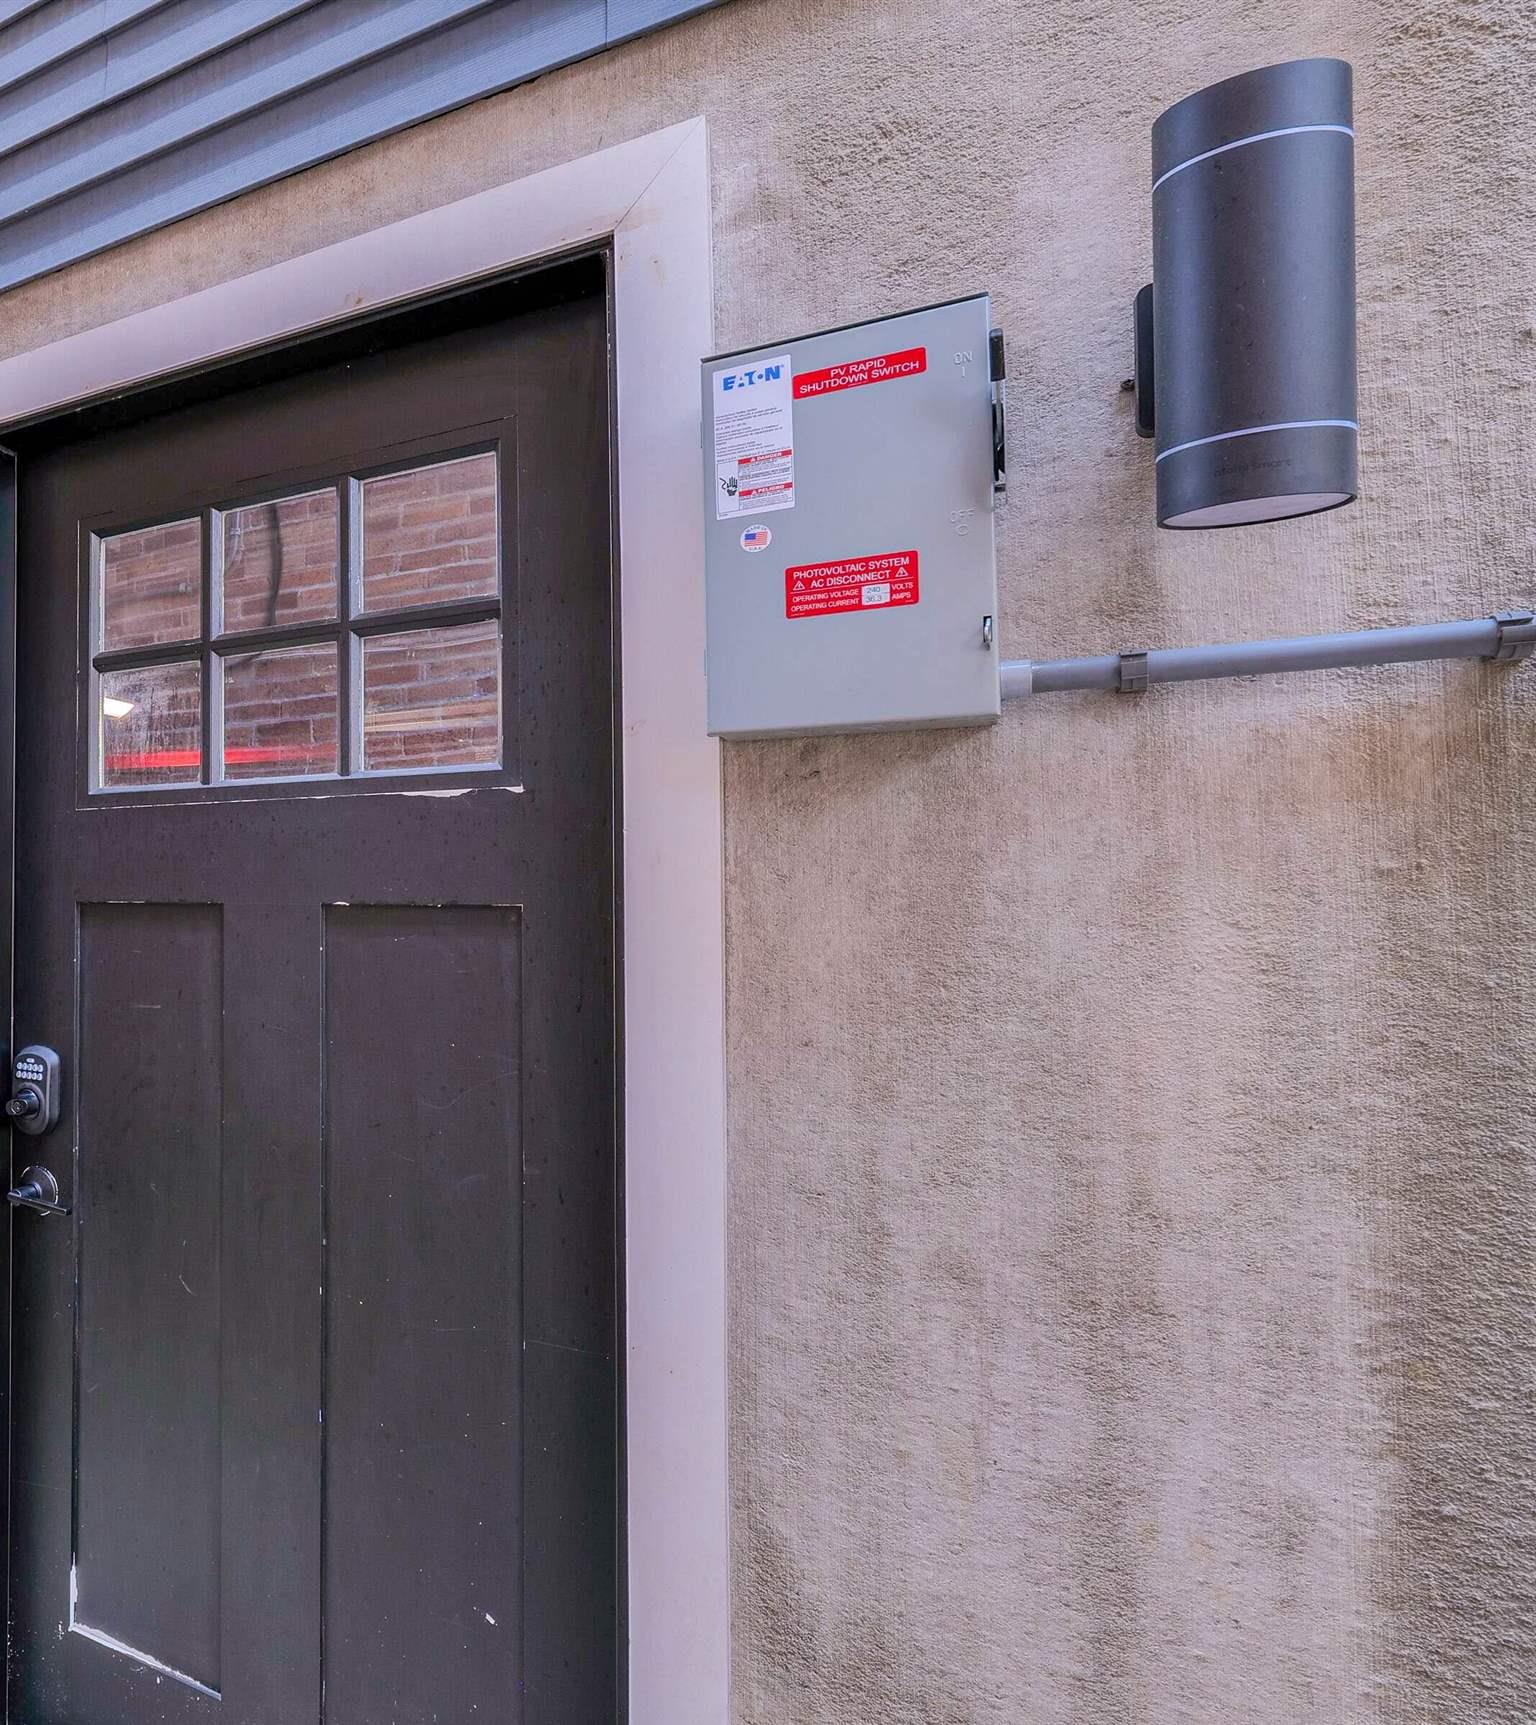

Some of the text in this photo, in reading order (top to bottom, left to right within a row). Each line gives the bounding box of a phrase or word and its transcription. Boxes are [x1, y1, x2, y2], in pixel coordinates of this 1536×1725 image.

[799, 372, 869, 394] SHUTDOWN
[871, 360, 920, 379] SWITCH
[830, 357, 886, 378] PV RAPID
[793, 556, 910, 580] PHOTOVOLTAIC SYSTEM
[810, 570, 892, 589] AC DISCONNECT
[790, 601, 828, 613] OPERATING
[828, 598, 860, 609] CURRENT
[891, 591, 912, 601] AMPS
[792, 591, 829, 603] OPERATING
[829, 588, 860, 600] VOLTAGE
[891, 581, 914, 591] VOLTS
